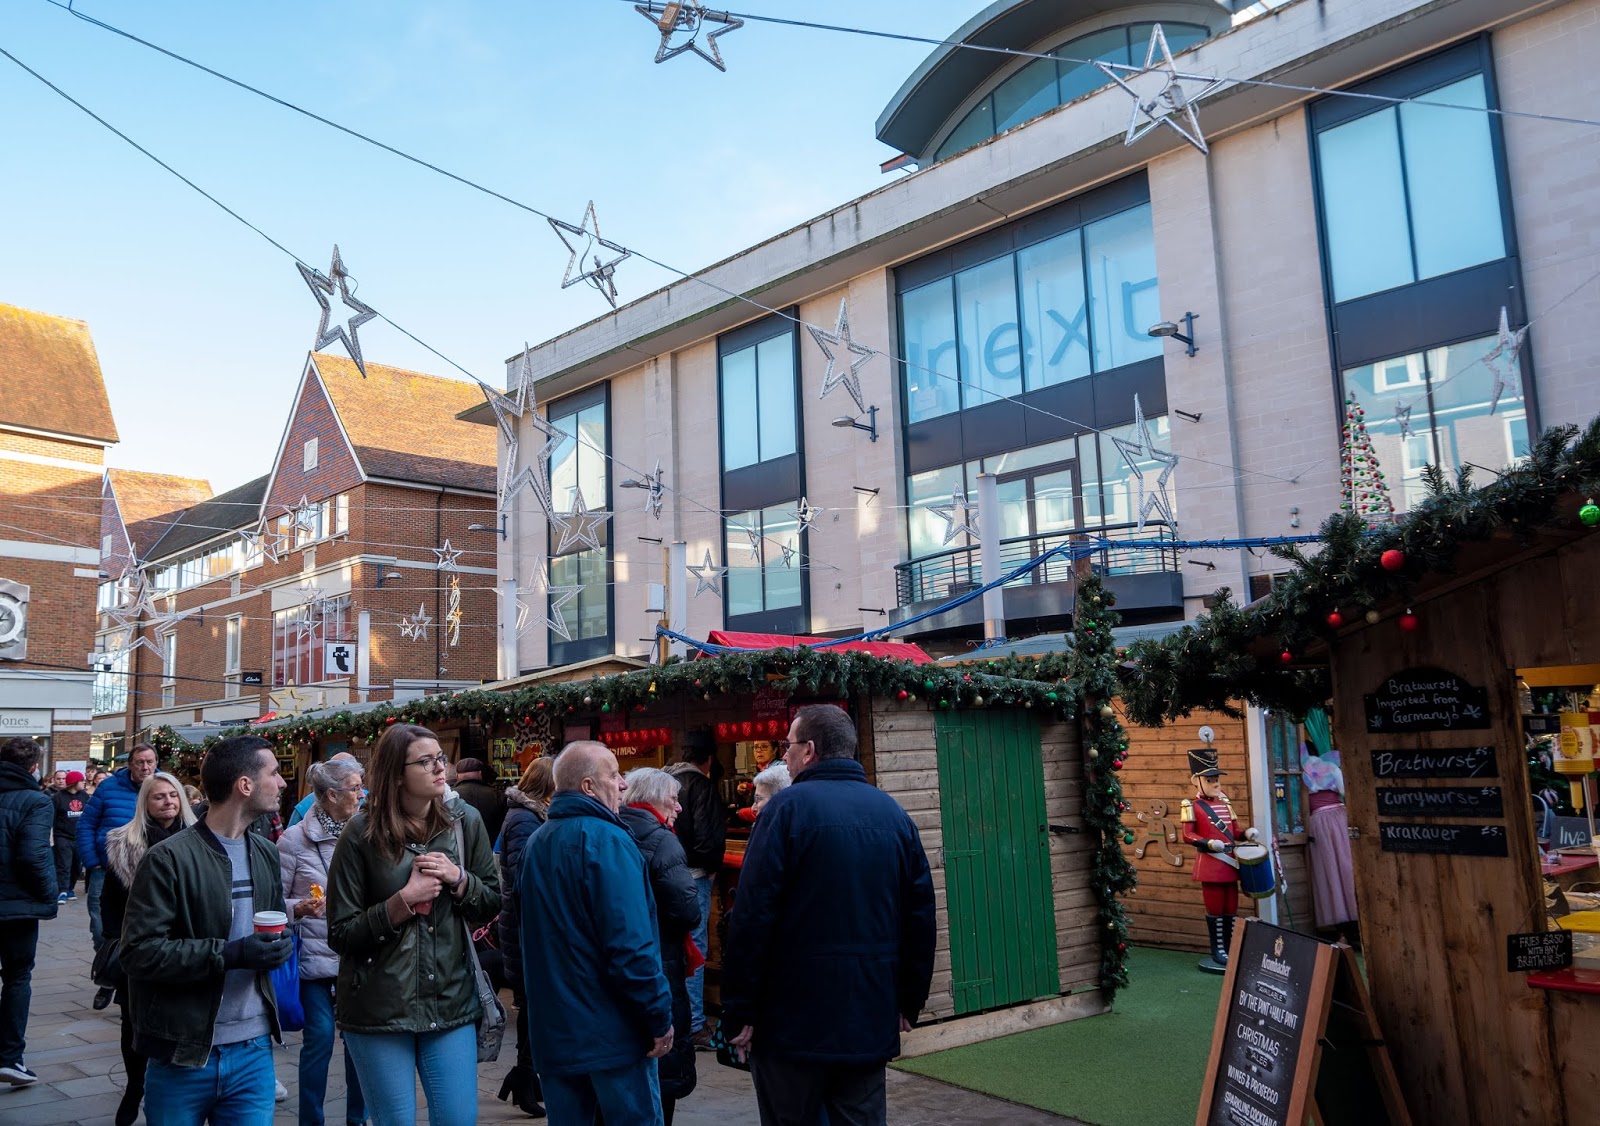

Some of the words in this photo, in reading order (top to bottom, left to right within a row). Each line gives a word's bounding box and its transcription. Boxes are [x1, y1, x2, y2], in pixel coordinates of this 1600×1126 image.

[926, 276, 1164, 388] next
[1376, 696, 1429, 710] Imported
[1433, 694, 1460, 705] from
[1376, 751, 1478, 776] Bratwurst
[1384, 791, 1480, 809] Currywurst
[1560, 826, 1587, 846] live
[1519, 936, 1540, 948] FRIES
[1527, 946, 1544, 955] WITH
[1544, 945, 1559, 955] ANY
[1261, 953, 1292, 977] Krombacher
[1516, 953, 1566, 969] BRATWURST
[1239, 989, 1248, 1006] BY
[1247, 994, 1259, 1012] THE
[1257, 999, 1271, 1016] PINT
[1271, 1006, 1286, 1023] HALF
[1284, 1011, 1298, 1030] PINT
[1237, 1023, 1280, 1056] CHRISTMAS
[1227, 1064, 1245, 1085] WINES
[1245, 1074, 1251, 1089] &
[1250, 1078, 1279, 1105] PROSECCO
[1224, 1091, 1251, 1115] SPARKLING
